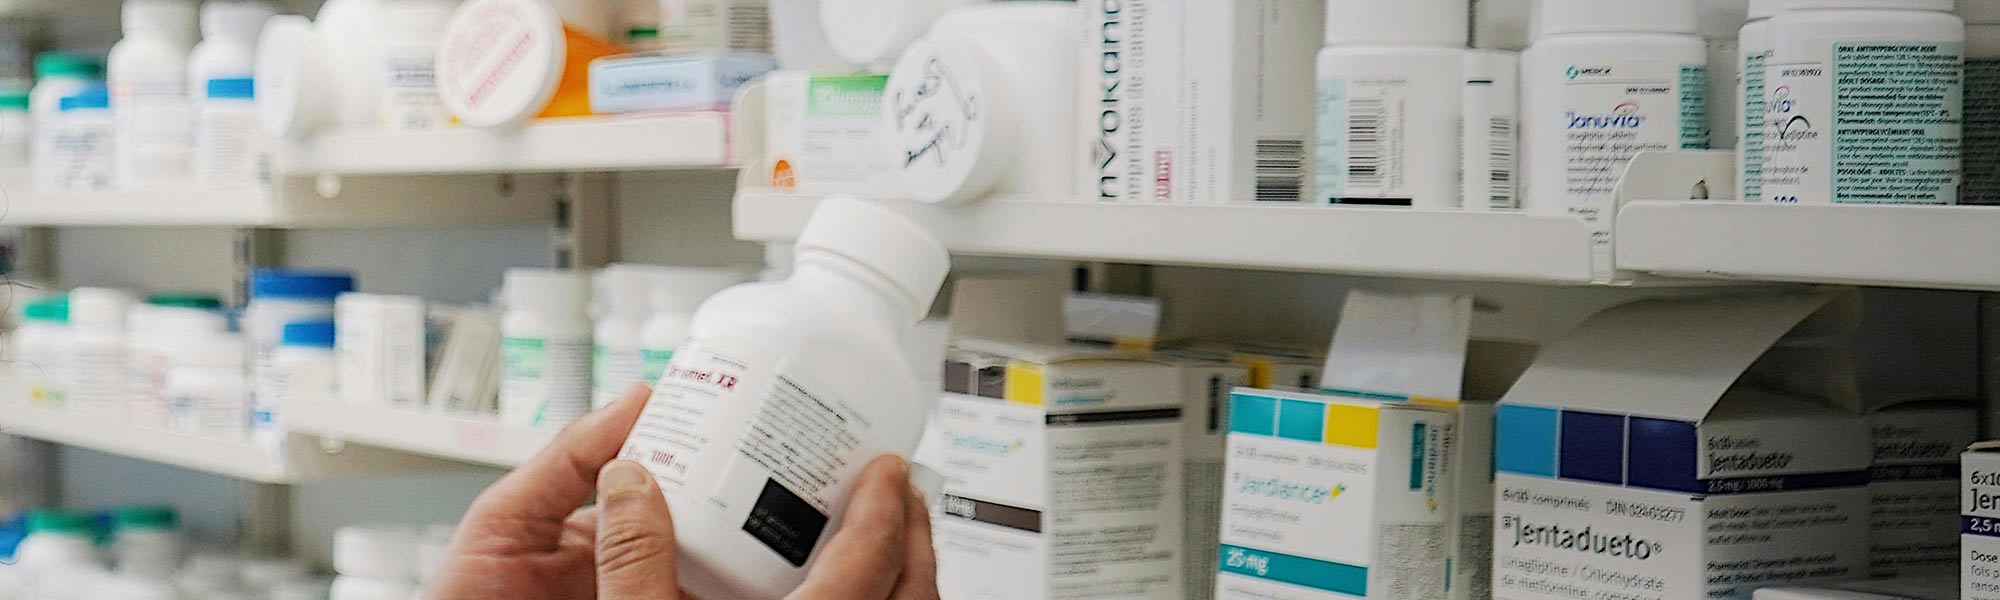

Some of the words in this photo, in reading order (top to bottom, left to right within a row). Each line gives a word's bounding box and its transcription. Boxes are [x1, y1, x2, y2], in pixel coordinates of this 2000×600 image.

[1567, 112, 1640, 129] Januvia
[1970, 518, 1992, 533] 2,5
[1226, 549, 1246, 568] 25
[1246, 556, 1269, 576] mg
[1970, 550, 1998, 564] Dose
[1970, 564, 1990, 578] fois
